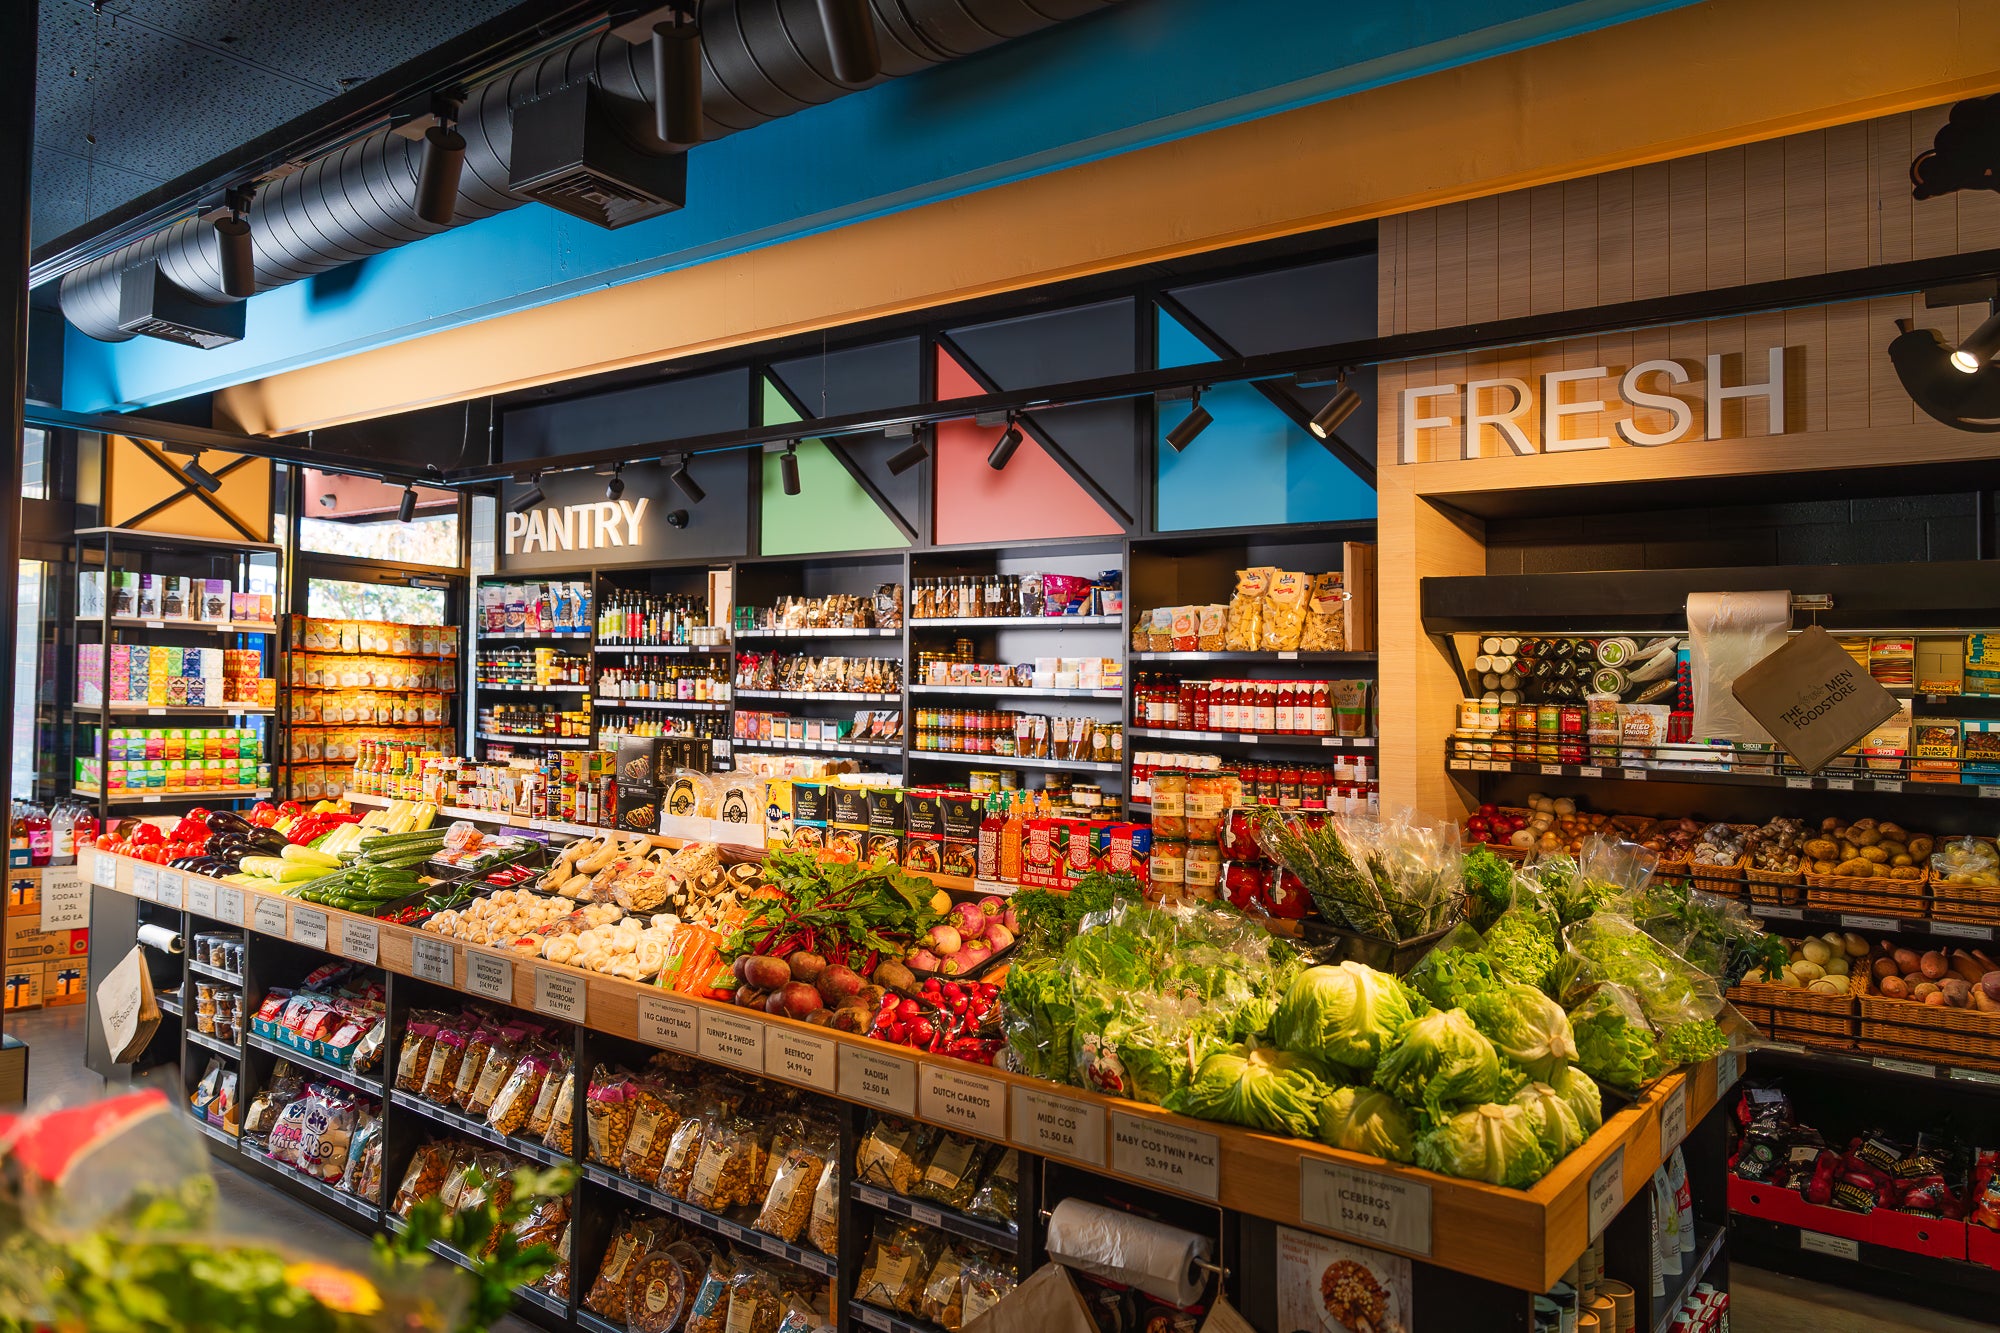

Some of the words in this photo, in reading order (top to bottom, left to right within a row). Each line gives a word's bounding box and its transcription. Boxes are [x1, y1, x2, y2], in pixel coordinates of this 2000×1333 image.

[1403, 347, 1784, 464] FRESH
[505, 498, 649, 555] PANTRY
[1780, 705, 1804, 724] THE
[1824, 669, 1853, 692] MEN
[1793, 682, 1857, 730] FOODSTORE
[52, 881, 83, 890] REMEDY
[51, 892, 83, 901] SODALY
[425, 953, 449, 965] MUSHROOMS
[476, 972, 503, 985] MUSHROOMS
[549, 982, 562, 991] SWISS
[562, 985, 573, 993] FLAT
[546, 990, 575, 1004] MUSHROOMS
[563, 1004, 571, 1012] KG
[644, 1012, 655, 1020] 1KG
[655, 1014, 676, 1025] CARROT
[676, 1019, 691, 1029] BAGS
[656, 1026, 670, 1036] $2.49
[670, 1030, 678, 1039] EA
[706, 1027, 728, 1040] TURNIPS
[728, 1033, 733, 1041] &
[733, 1034, 756, 1047] SWEDES
[718, 1043, 734, 1054] $4.99
[733, 1048, 743, 1056] KG
[784, 1047, 814, 1062] BEETROOT
[786, 1060, 803, 1072] $4.99
[803, 1065, 812, 1077] kg
[868, 1056, 878, 1064] MEN
[864, 1067, 889, 1082] RADISH
[934, 1072, 944, 1080] THE
[953, 1076, 964, 1085] MEN
[963, 1078, 990, 1091] FOODSTORE
[862, 1081, 881, 1094] $2.50
[881, 1086, 890, 1096] EA
[932, 1086, 956, 1100] DUTCH
[957, 1090, 991, 1108] CARROTS
[945, 1103, 965, 1116] $4.99
[966, 1109, 977, 1120] EA
[1027, 1095, 1036, 1103] THE
[1047, 1100, 1058, 1109] MEN
[1058, 1102, 1088, 1116] FOODSTORE
[1037, 1112, 1056, 1125] MIDI
[1057, 1117, 1077, 1130] COS
[1039, 1128, 1062, 1142] $3.50
[1063, 1134, 1074, 1145] EA
[1130, 1121, 1140, 1130] THE
[1153, 1126, 1166, 1136] MEN
[1166, 1129, 1198, 1144] FOODSTORE
[1116, 1132, 1139, 1146] BABY
[1141, 1137, 1162, 1152] COS
[1163, 1144, 1186, 1159] TWIN
[1187, 1150, 1215, 1167] PACK
[1145, 1156, 1169, 1171] $3.99
[1171, 1163, 1183, 1175] EA
[1324, 1168, 1336, 1178] THE
[1338, 1188, 1391, 1210] ICEBERGS
[1341, 1207, 1370, 1223] $3.49
[1372, 1216, 1388, 1229] EA
